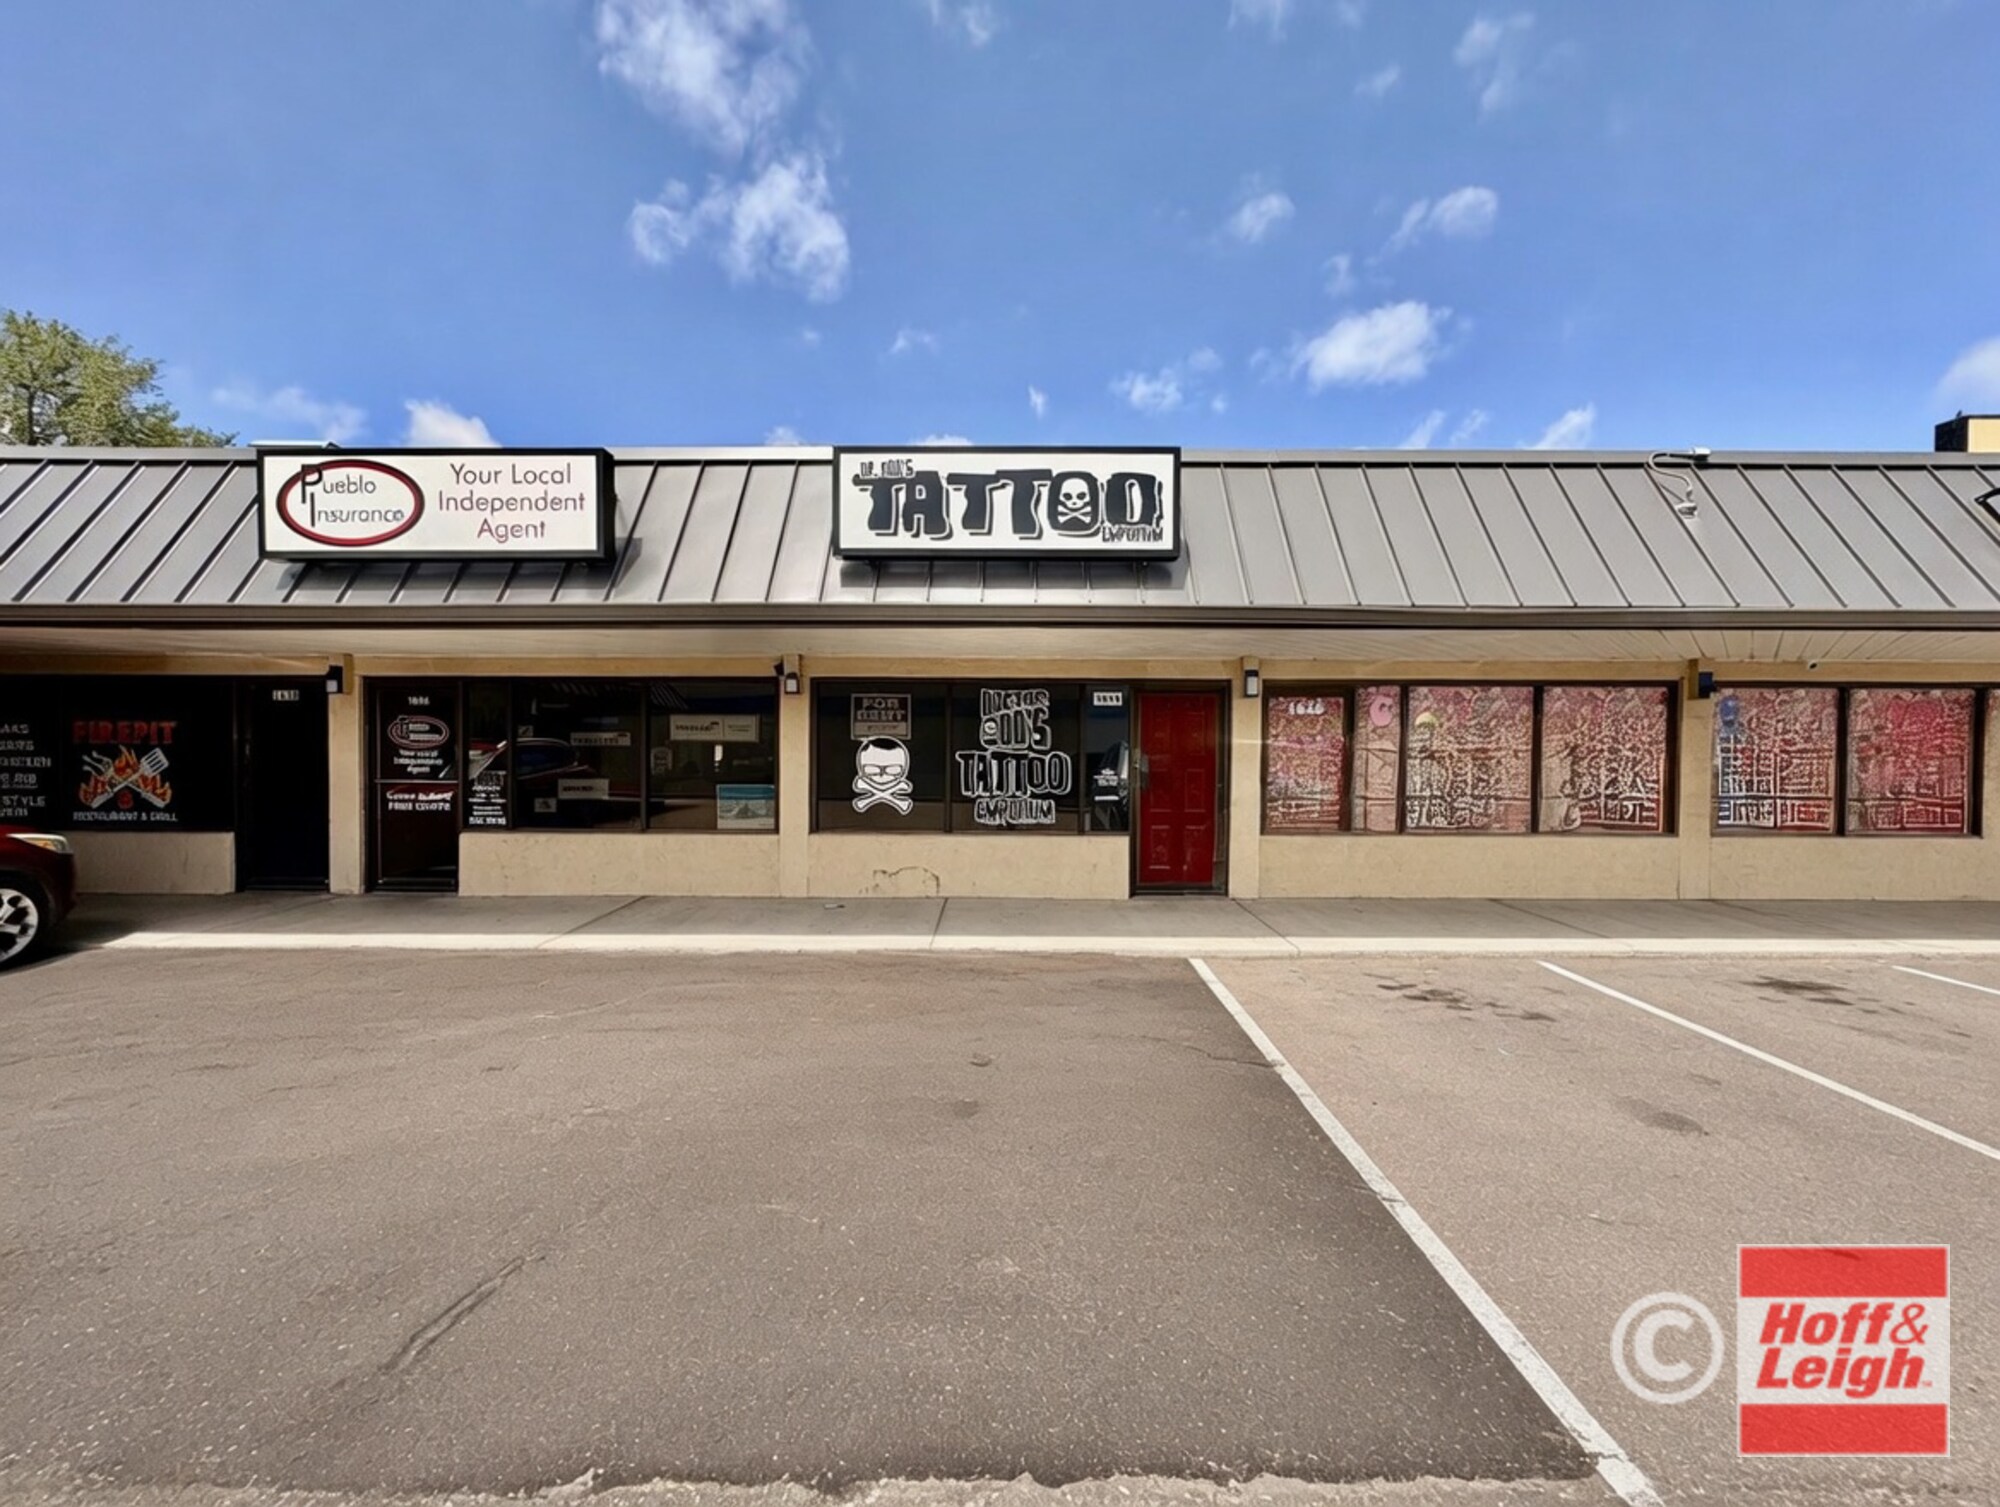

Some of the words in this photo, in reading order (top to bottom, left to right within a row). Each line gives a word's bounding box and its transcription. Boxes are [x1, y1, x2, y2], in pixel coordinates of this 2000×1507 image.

[301, 464, 376, 504] Pueblo
[450, 463, 501, 485] Your
[511, 463, 571, 485] Local
[310, 492, 404, 527] Insurance
[438, 491, 585, 516] Independent
[852, 468, 1164, 541] TATTOO
[476, 518, 545, 543] Agent
[72, 720, 178, 745] FIREPIT
[955, 751, 1072, 799] TATTOO
